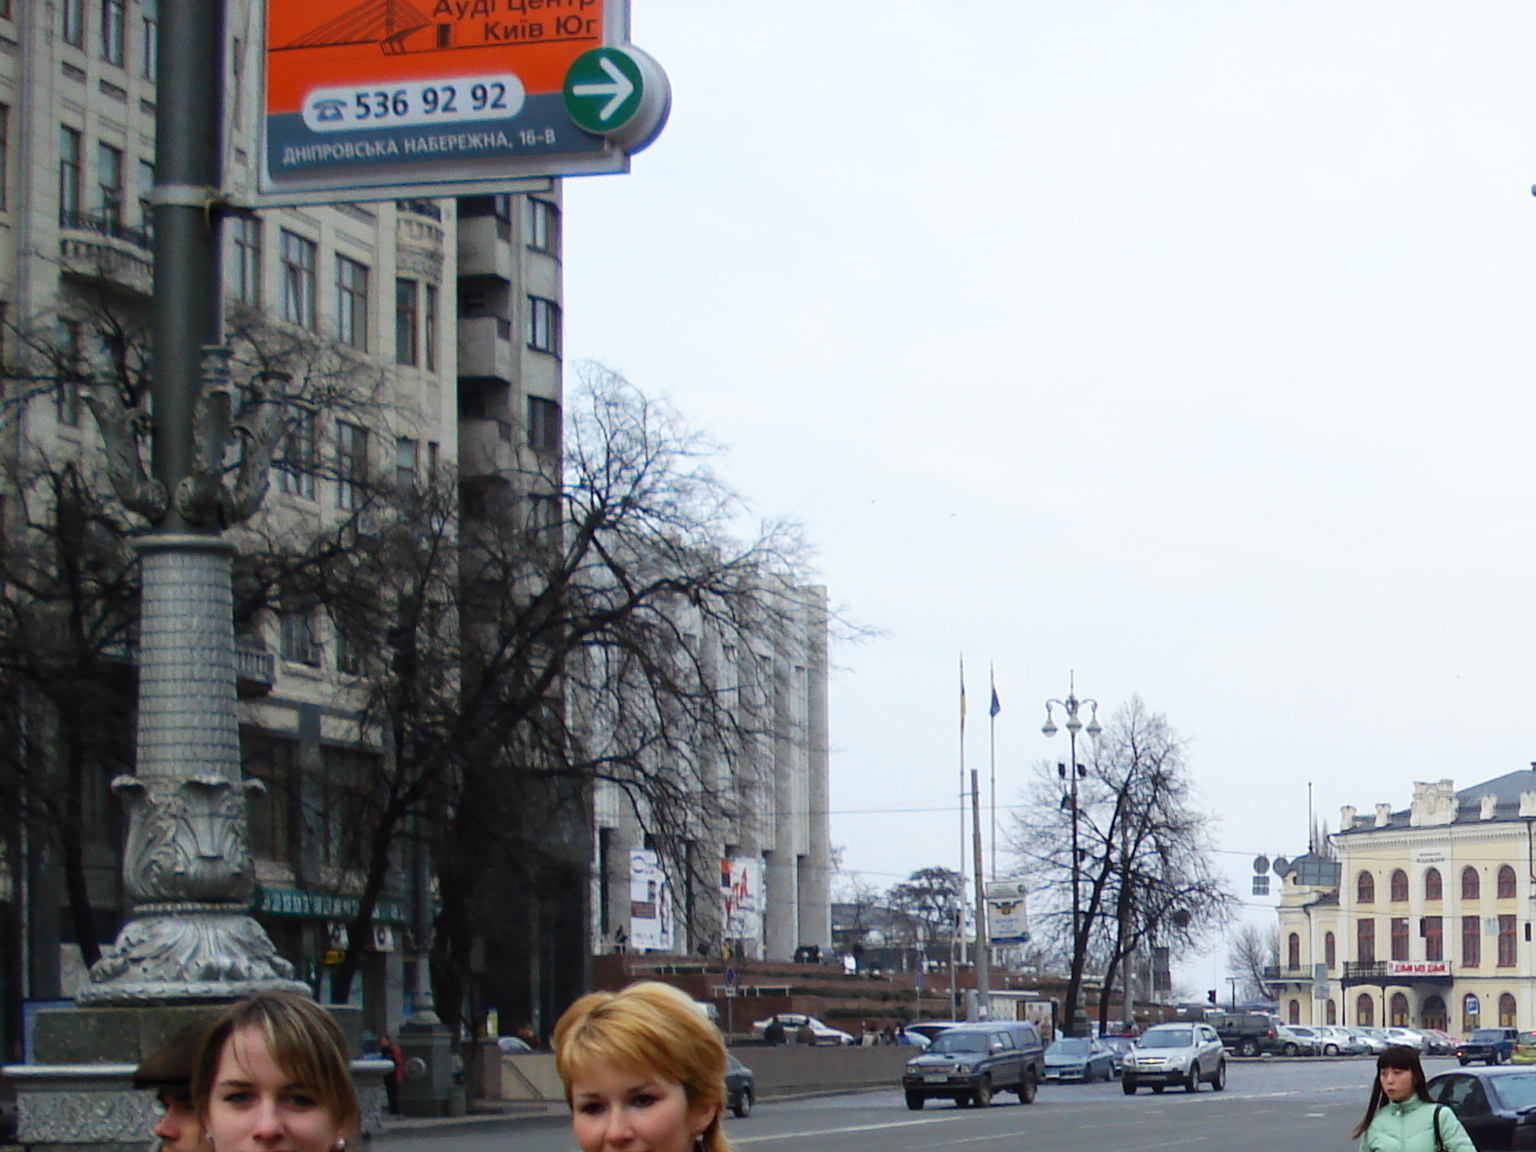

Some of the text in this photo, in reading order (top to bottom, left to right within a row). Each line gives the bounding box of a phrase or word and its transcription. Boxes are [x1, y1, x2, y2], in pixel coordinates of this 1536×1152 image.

[484, 14, 597, 41] Київ Юг
[354, 81, 507, 120] 536 92 92
[281, 140, 399, 166] ДНІПРОВСЬКА
[403, 130, 513, 154] НАБЕРЕЖНА,
